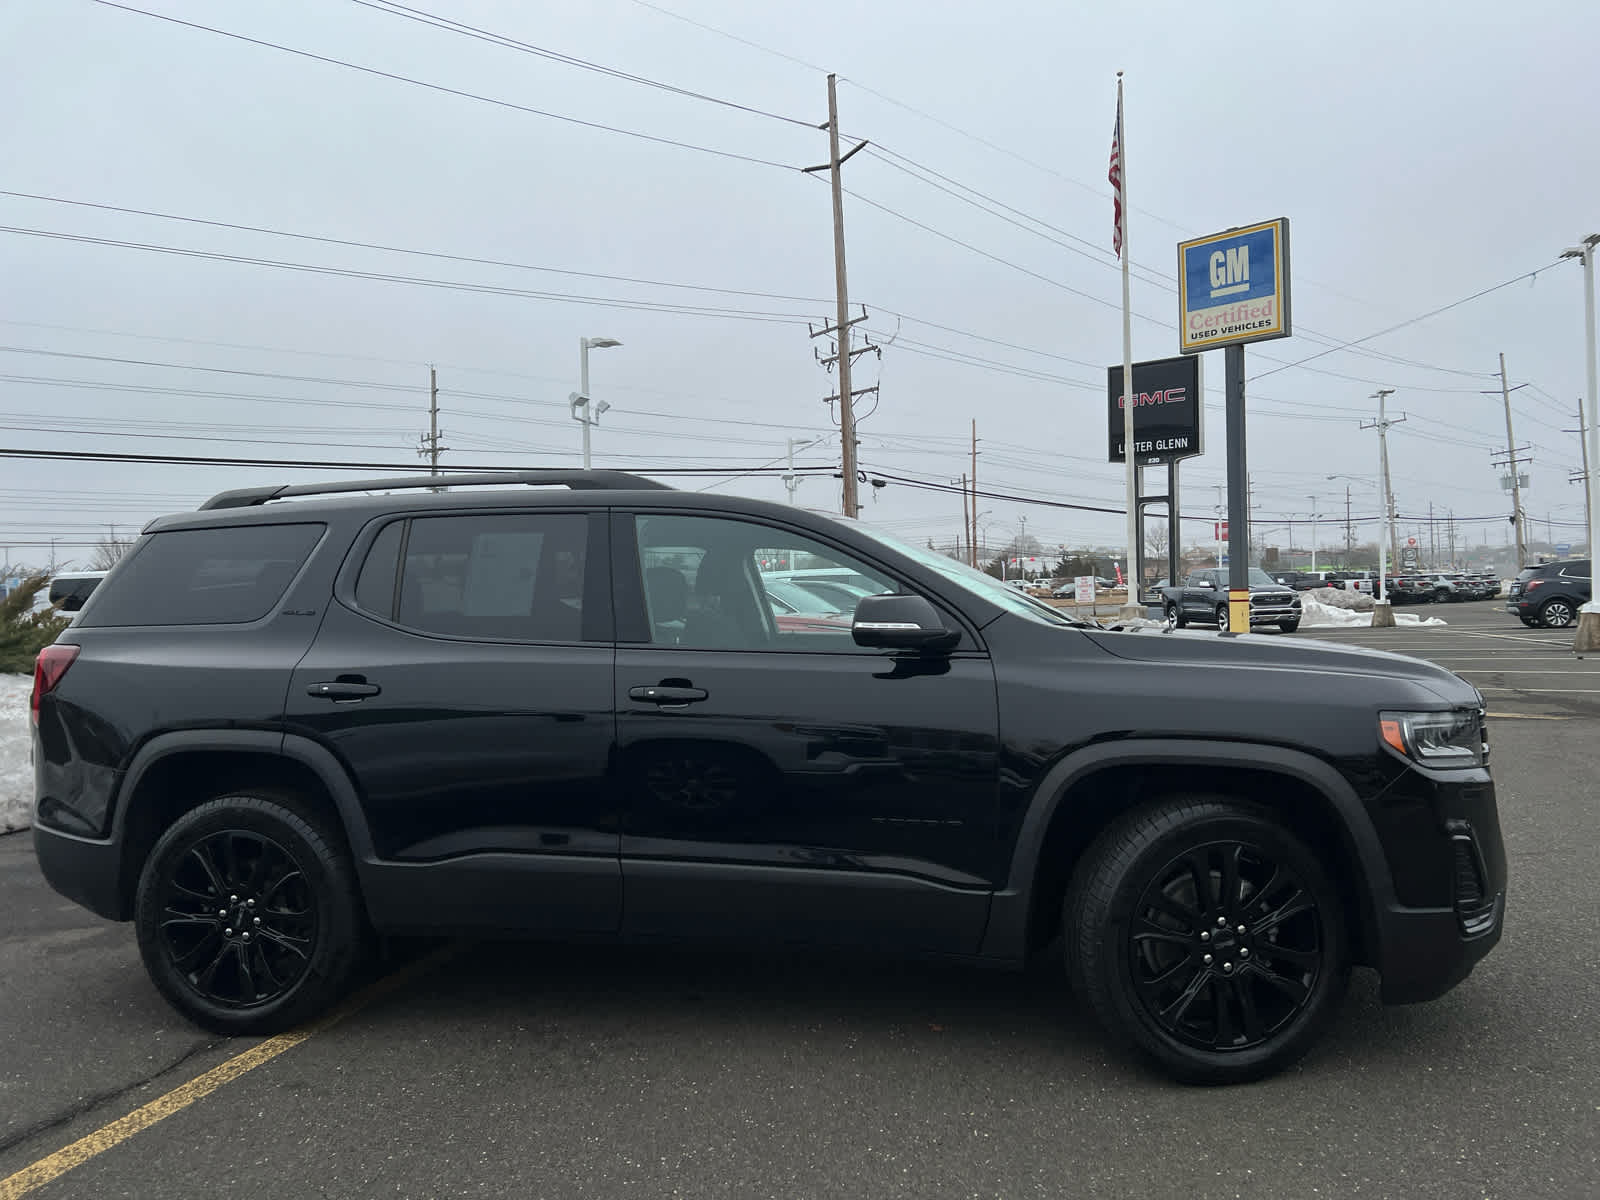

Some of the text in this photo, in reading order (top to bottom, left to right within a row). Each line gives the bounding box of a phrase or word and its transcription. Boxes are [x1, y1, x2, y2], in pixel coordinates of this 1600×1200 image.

[1209, 245, 1250, 289] GM
[1189, 300, 1273, 330] Certified
[1191, 319, 1272, 340] USED VEHICLES
[1118, 438, 1188, 455] LTER GLENN
